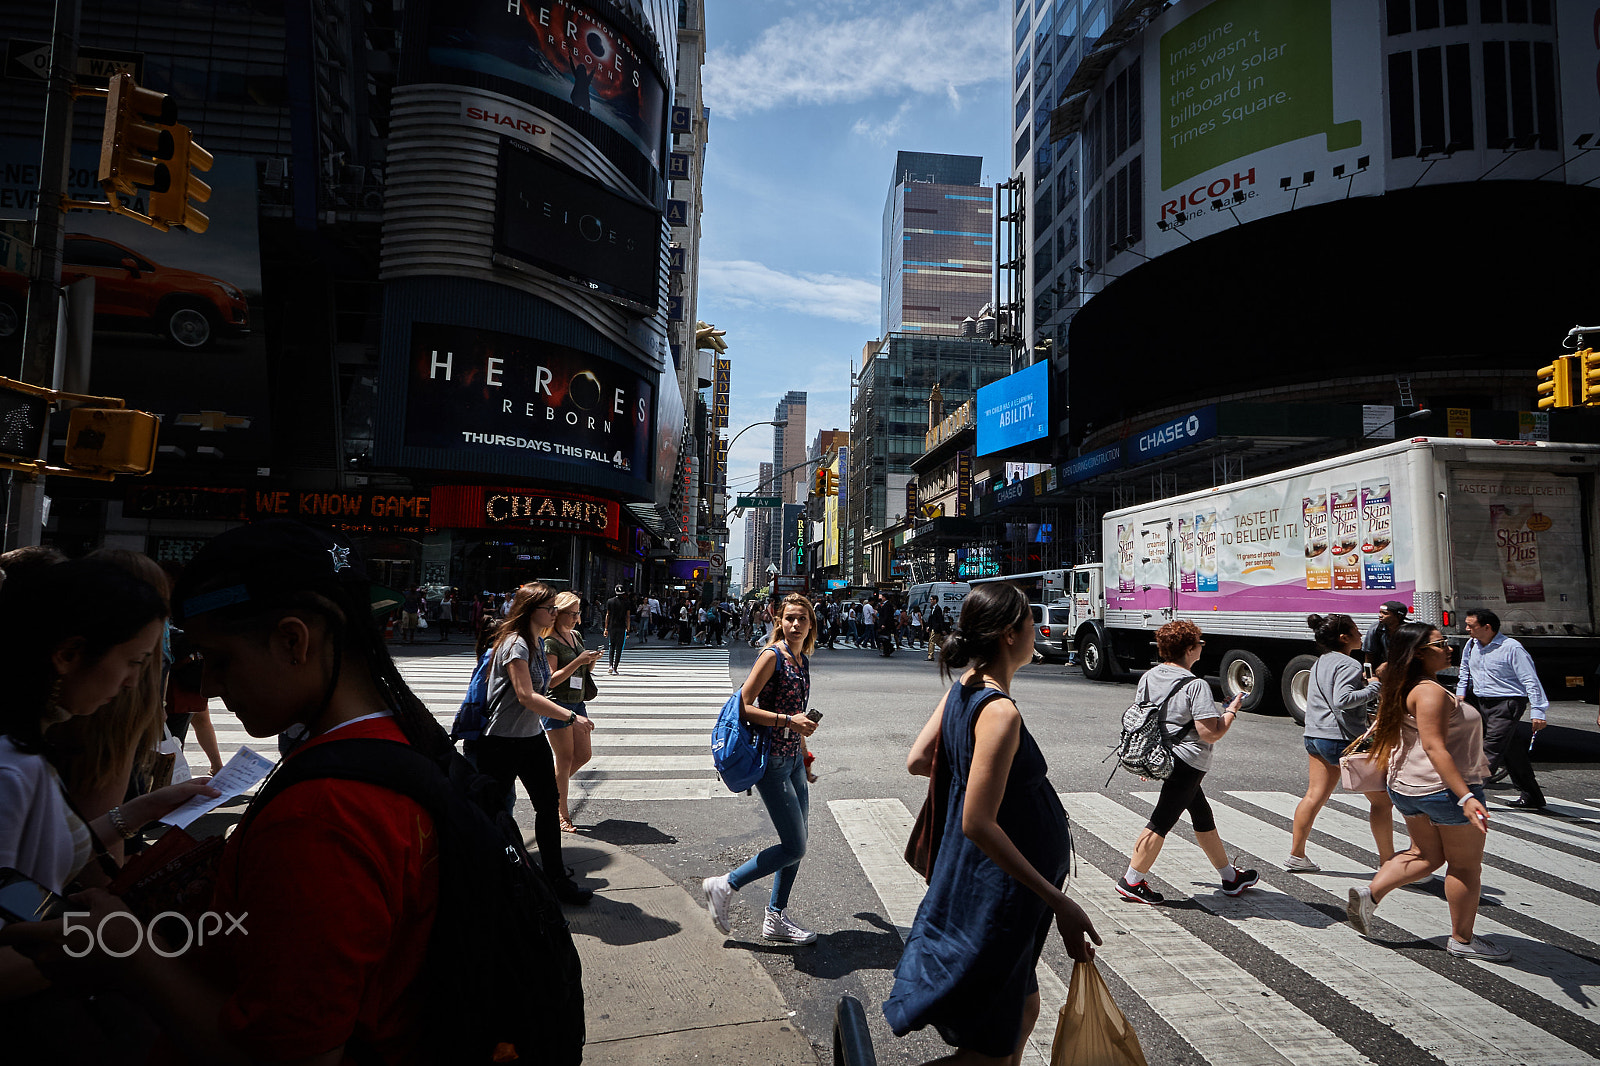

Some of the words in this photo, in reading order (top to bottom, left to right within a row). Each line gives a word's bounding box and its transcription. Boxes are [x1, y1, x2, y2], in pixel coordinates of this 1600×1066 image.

[1169, 22, 1234, 65] Imagine
[548, 34, 613, 81] REBORN
[1170, 63, 1197, 86] this
[1201, 29, 1261, 67] wasn't
[1170, 86, 1195, 107] the
[1200, 64, 1236, 91] only
[1241, 43, 1288, 71] solar
[1170, 80, 1241, 128] billboard
[1248, 75, 1265, 92] in
[466, 106, 546, 136] SHARP
[1170, 118, 1216, 149] Times
[1222, 90, 1293, 121] Square.
[1161, 167, 1256, 221] RICOH
[429, 350, 646, 423] HEROES
[717, 360, 730, 428] MADAME
[502, 398, 611, 434] REBORN
[1139, 421, 1184, 452] CHASE
[462, 431, 552, 453] THURSDAYS
[553, 443, 583, 459] THIS
[584, 448, 610, 464] FALL
[612, 450, 623, 466] 4
[1062, 467, 1072, 478] OPEN
[1073, 460, 1088, 474] DURING
[1087, 447, 1120, 470] CONSTRUCTION
[960, 453, 969, 497] VICTORY
[997, 489, 1017, 503] CHASE
[1458, 484, 1486, 494] TASTE
[1489, 485, 1497, 494] IT
[1500, 486, 1512, 495] TO
[1515, 486, 1553, 496] BELIEVE
[1555, 486, 1565, 496] IT!
[256, 490, 290, 513] WE
[298, 493, 363, 516] KNOW
[680, 456, 692, 544] AMSTERDAM
[750, 498, 756, 506] 7
[757, 498, 769, 506] Av
[486, 494, 608, 530] CHAMPS
[1234, 511, 1268, 528] TASTE
[1269, 508, 1279, 522] IT
[1304, 513, 1327, 528] Skim
[1333, 509, 1357, 525] Skim
[1363, 505, 1391, 521] Skim
[529, 518, 581, 530] SPORTS
[1308, 525, 1327, 539] Plus
[1337, 521, 1357, 536] Plus
[1368, 518, 1390, 533] Plus
[1179, 532, 1194, 543] Skim
[1196, 531, 1216, 546] Skim
[1220, 532, 1233, 546] TO
[1236, 525, 1281, 544] BELIEVE
[1283, 523, 1298, 538] IT!
[1497, 529, 1536, 547] Skim
[1118, 540, 1134, 553] Skim
[1182, 541, 1194, 552] Plus
[1200, 543, 1216, 557] Plus
[1242, 552, 1257, 561] grams
[1257, 551, 1262, 559] of
[1262, 550, 1281, 559] protein
[1507, 544, 1536, 562] Plus
[1121, 551, 1134, 563] Plus
[1245, 559, 1254, 567] per
[1254, 558, 1274, 567] serving!
